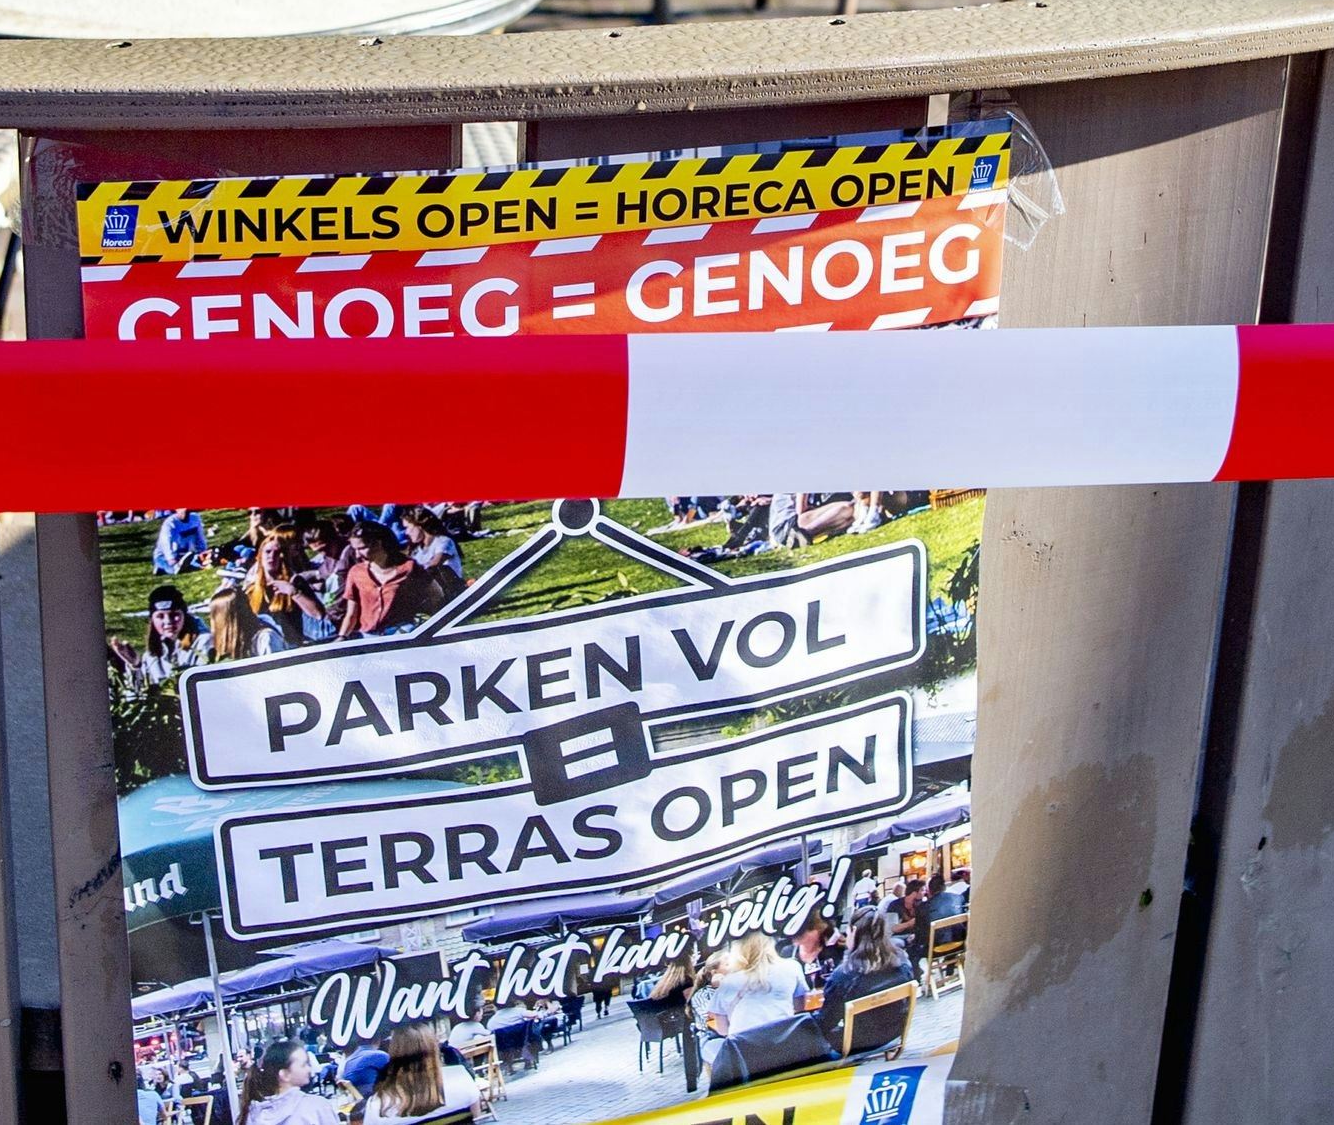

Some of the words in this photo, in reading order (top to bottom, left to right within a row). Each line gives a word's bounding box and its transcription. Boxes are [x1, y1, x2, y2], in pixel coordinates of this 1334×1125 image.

[102, 237, 133, 248] Horeca
[158, 203, 400, 245] WINKELS
[416, 196, 557, 239] OPEN
[616, 178, 816, 225] HORECA
[831, 165, 955, 207] OPEN
[117, 277, 520, 340] GENOEG
[625, 223, 982, 323] GENOEG
[264, 635, 643, 753] PARKEN
[671, 600, 846, 682] VOL
[258, 804, 623, 904] TERRAS
[650, 734, 877, 842] OPEN
[310, 951, 491, 1048] Want
[496, 933, 592, 1005] het
[593, 928, 690, 983] kan
[707, 856, 852, 948] veilig!
